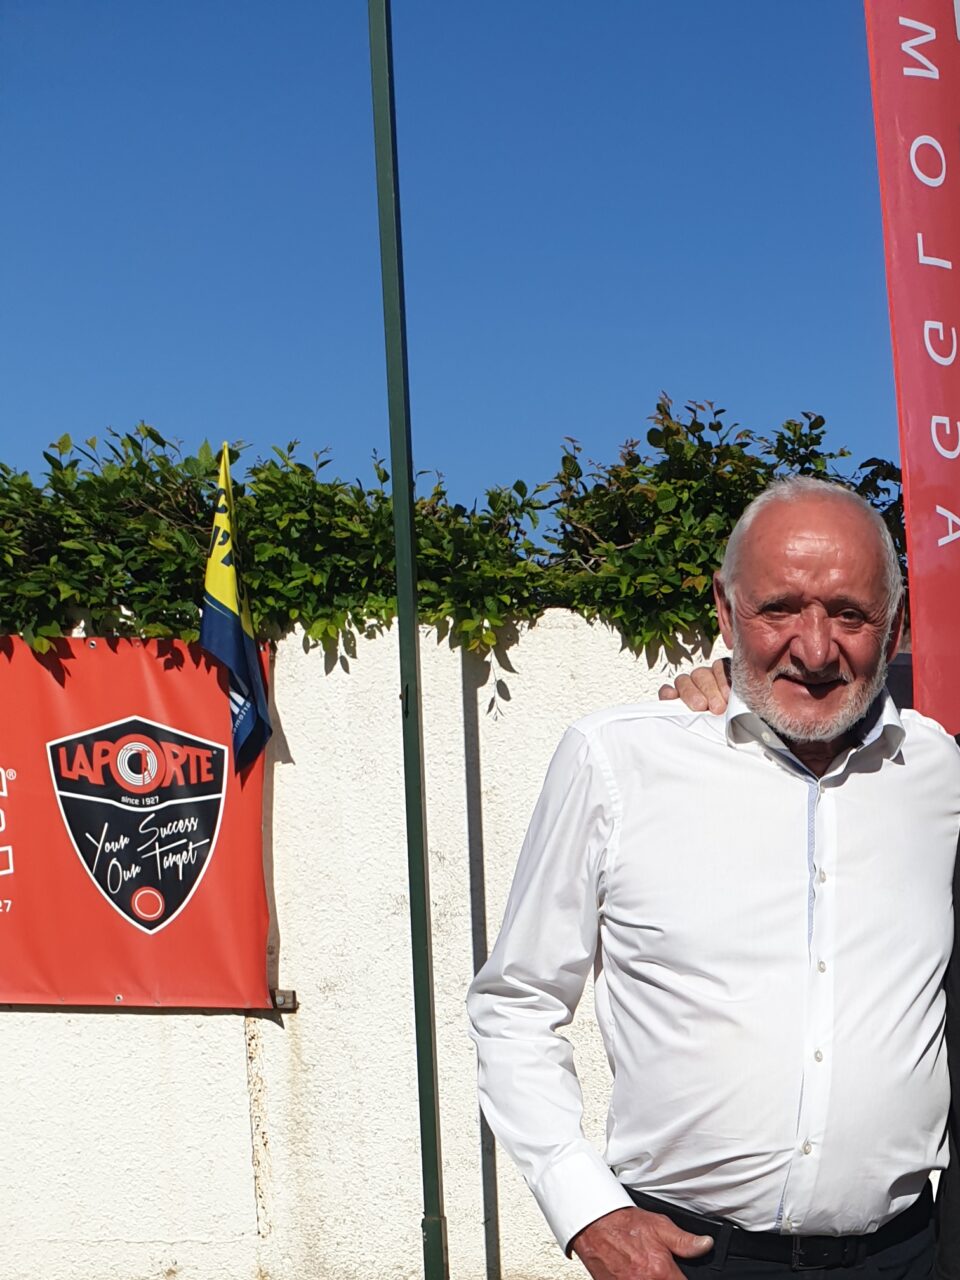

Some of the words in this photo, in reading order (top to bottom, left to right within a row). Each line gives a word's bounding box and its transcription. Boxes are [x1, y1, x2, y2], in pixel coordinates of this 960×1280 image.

[59, 734, 214, 794] LAPORTE
[121, 796, 139, 806] since
[142, 796, 159, 805] 1927
[85, 822, 130, 875] Your
[137, 813, 199, 852] Success
[107, 857, 142, 894] Our
[141, 838, 211, 880] Target
